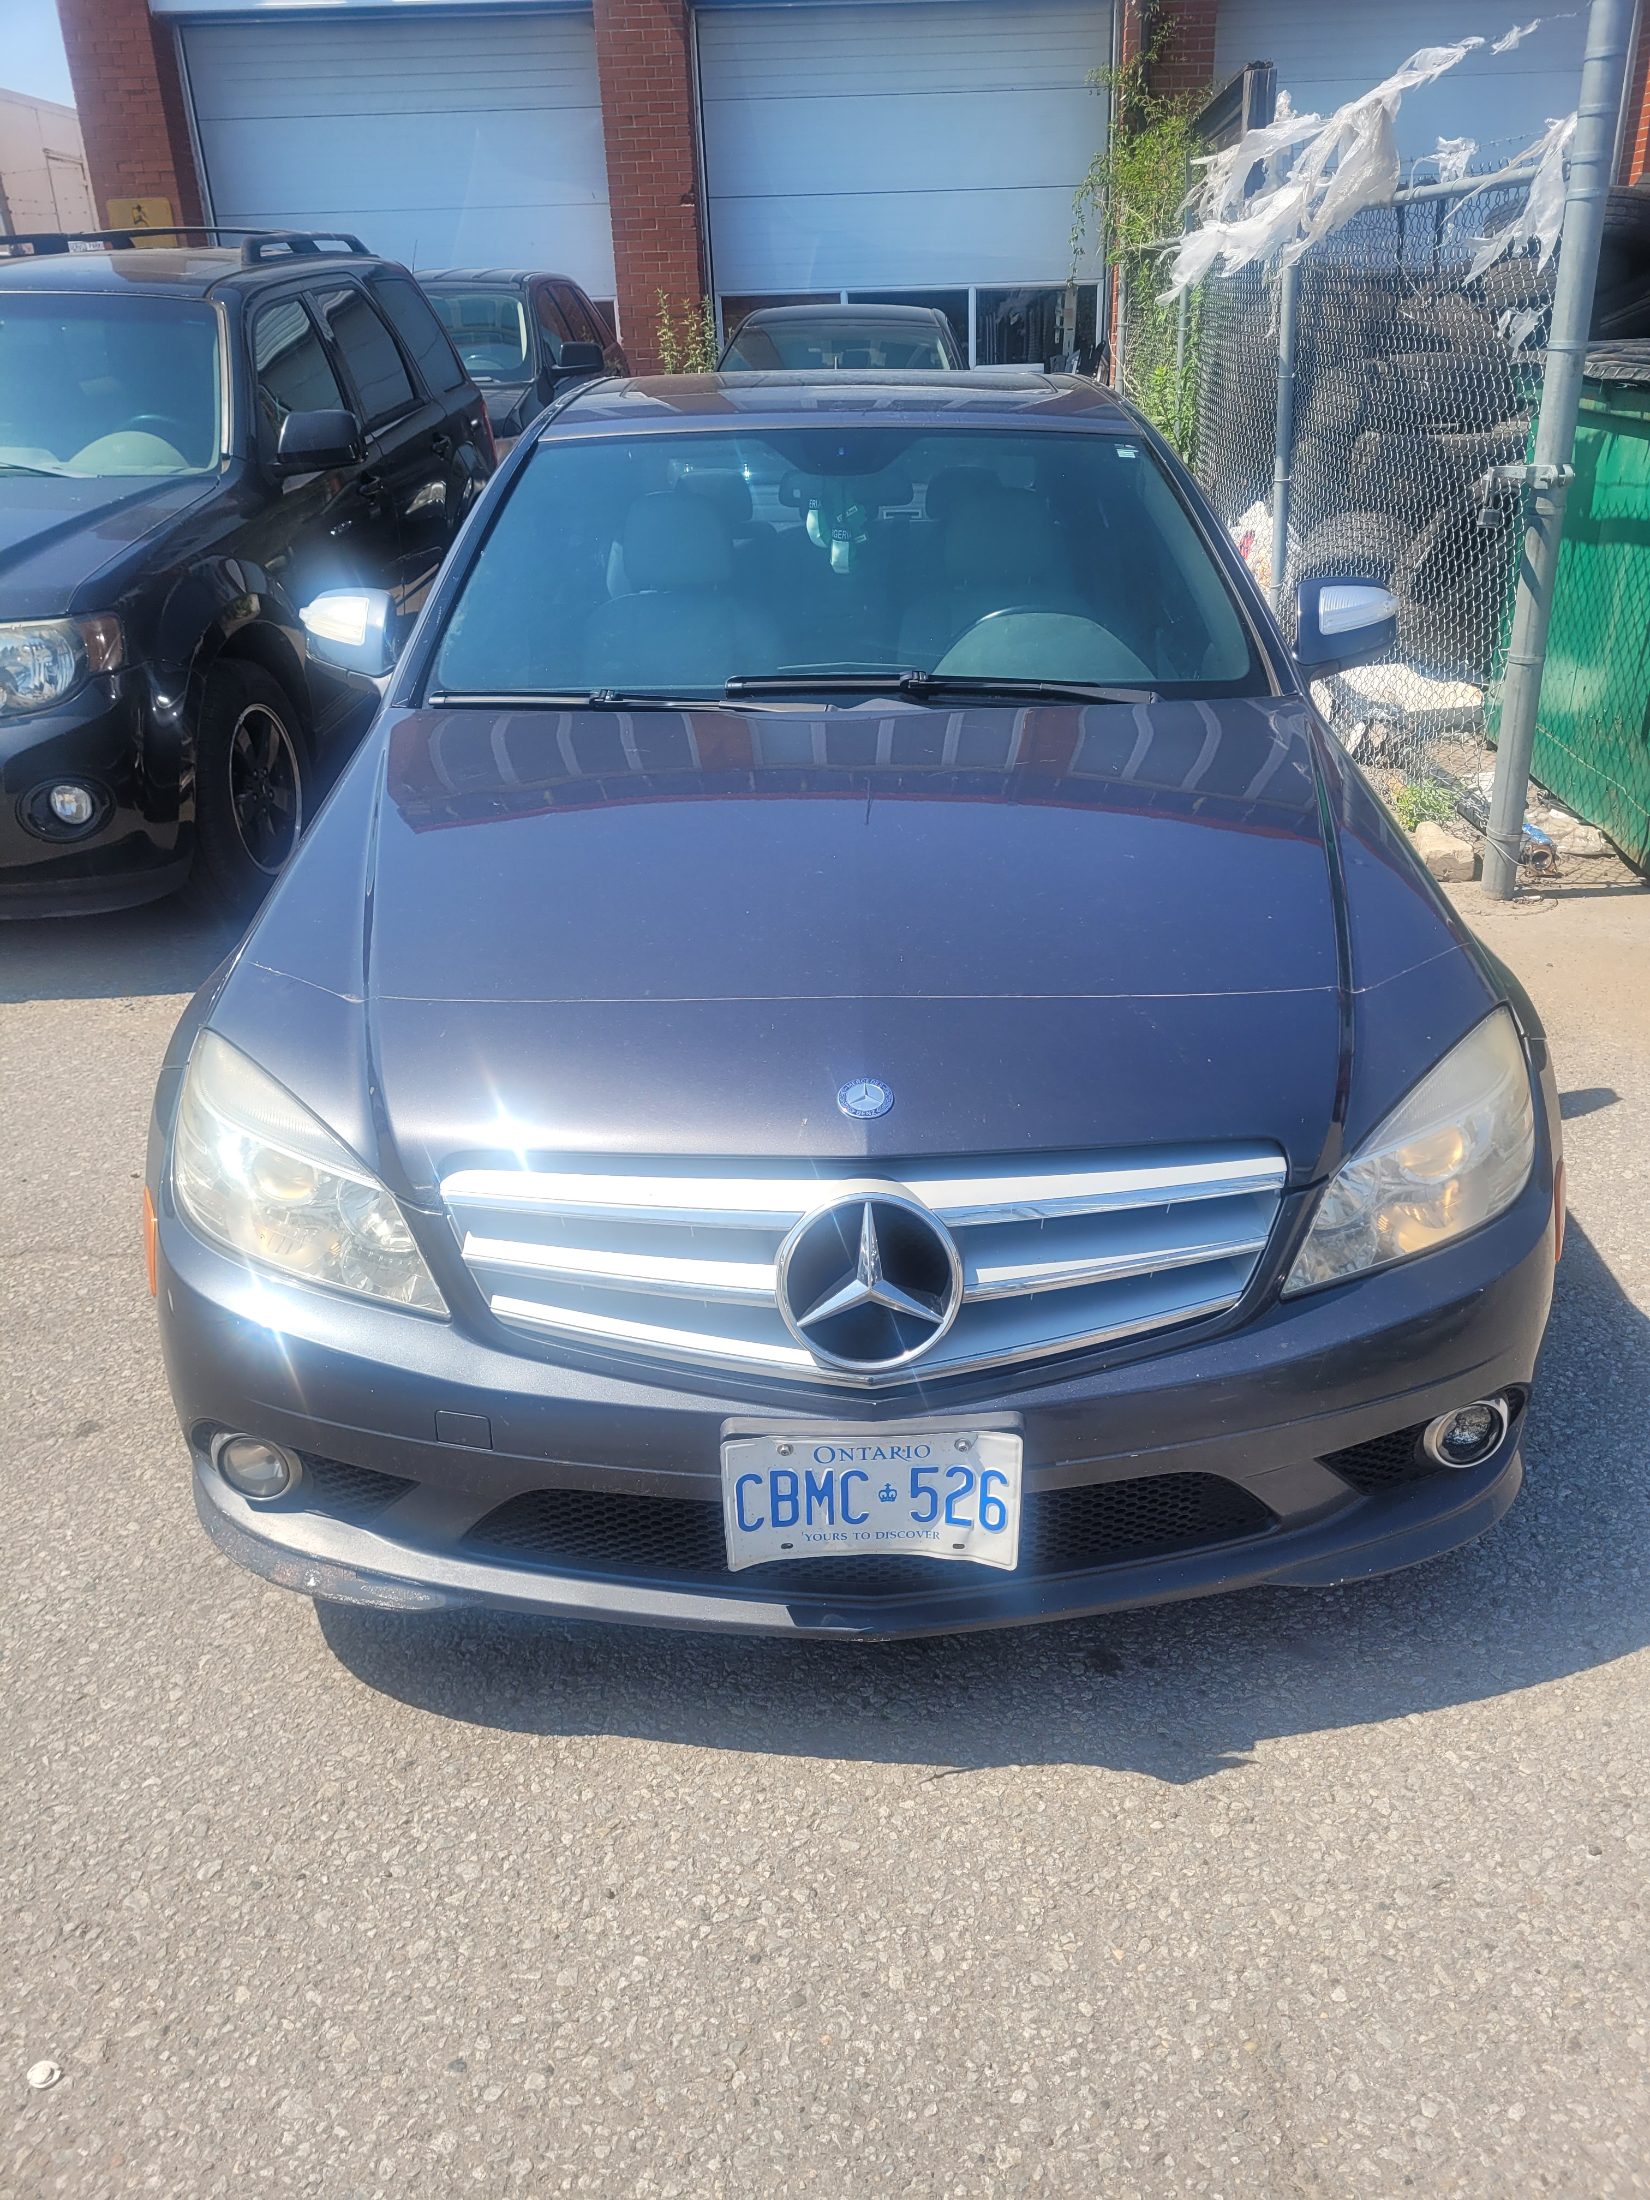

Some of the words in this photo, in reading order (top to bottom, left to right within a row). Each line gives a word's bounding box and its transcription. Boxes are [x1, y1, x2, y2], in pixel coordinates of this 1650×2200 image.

[813, 1444, 931, 1464] ONTARIO
[735, 1469, 870, 1532] CBMC
[910, 1466, 1008, 1532] 526
[803, 1531, 848, 1542] YOURS
[852, 1531, 871, 1541] TO
[875, 1530, 941, 1540] DISCOVER
